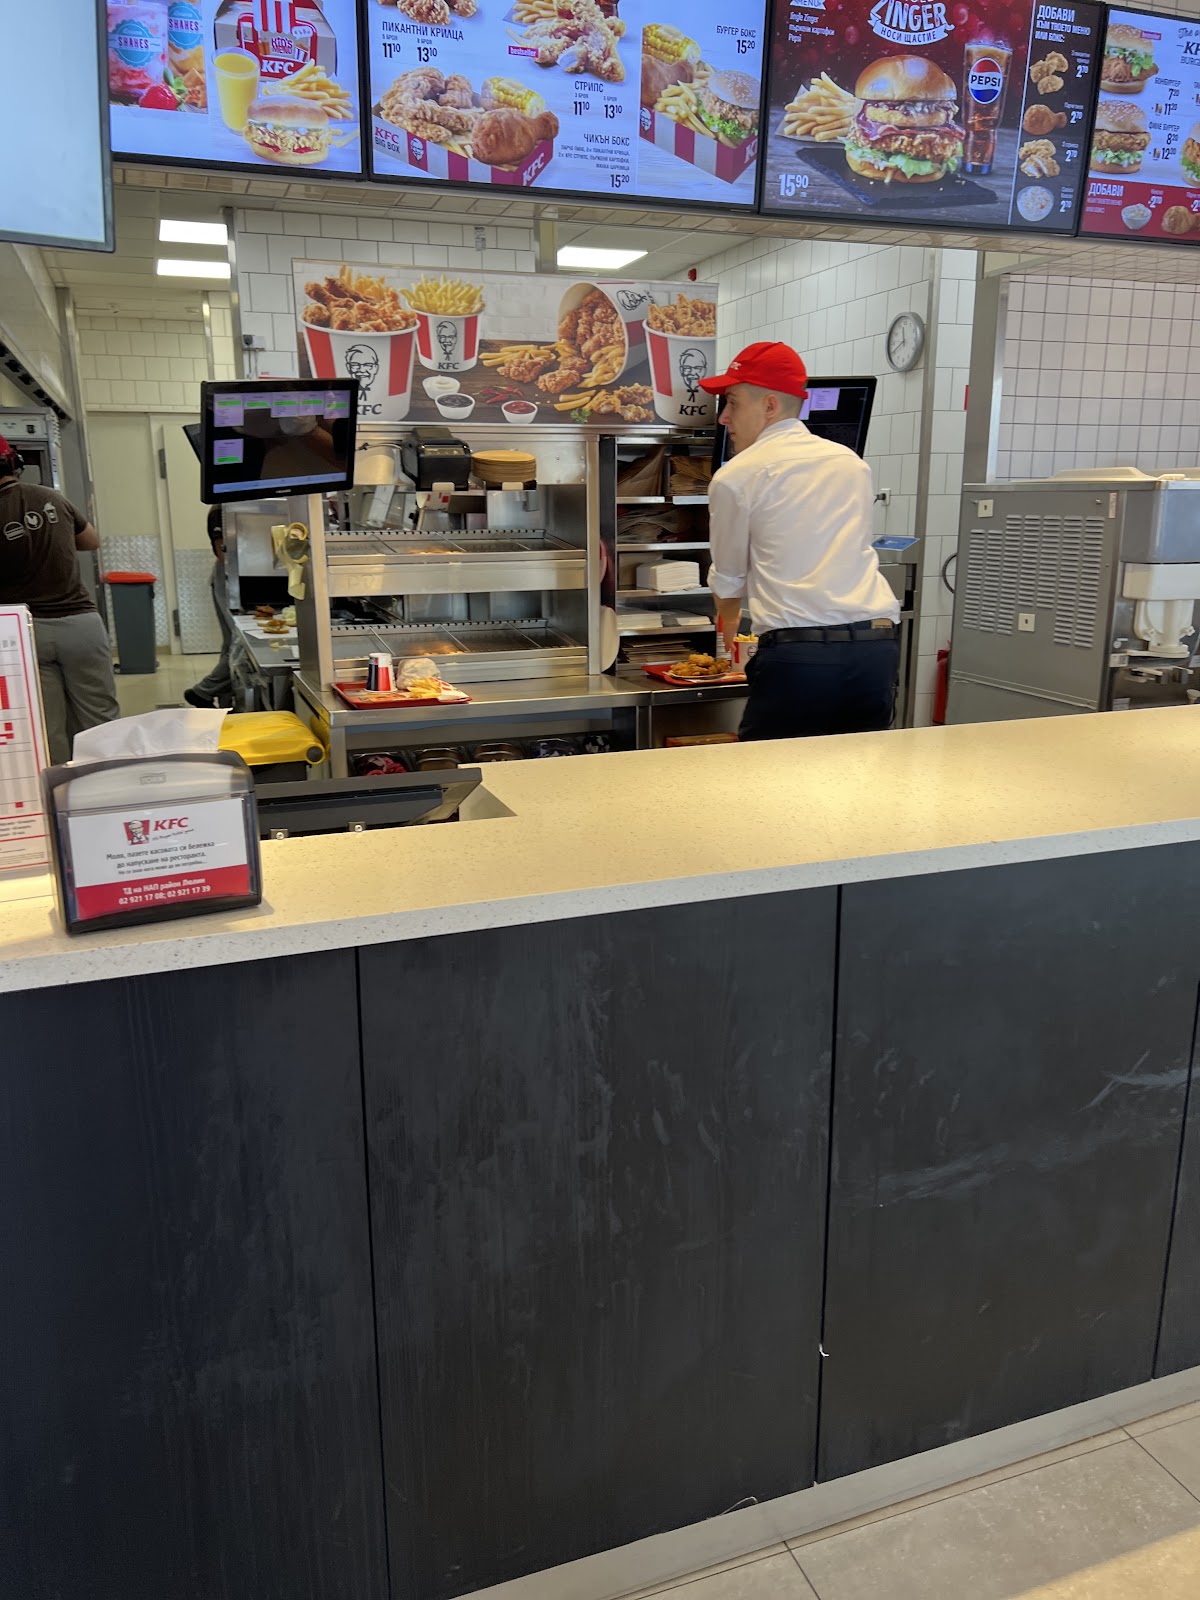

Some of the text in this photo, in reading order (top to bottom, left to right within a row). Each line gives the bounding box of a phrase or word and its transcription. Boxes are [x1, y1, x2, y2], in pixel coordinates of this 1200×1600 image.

[1037, 4, 1076, 22] ДОБАВИ
[168, 19, 199, 32] SHAKES
[382, 21, 464, 41] ПИКАНТНИ КРИЛЦА
[716, 25, 757, 38] БУРГЕР БОКС
[880, 27, 937, 44] НОСИ ЩАСТИЕ
[118, 36, 149, 49] SHAKES
[261, 60, 294, 74] KFC
[574, 81, 604, 92] СТРИПС
[970, 75, 1001, 88] PEPSI
[374, 126, 400, 144] KFC
[583, 133, 630, 146] ЧИКЪН БОКС
[387, 142, 400, 154] BOX
[522, 152, 545, 186] KFC
[1088, 182, 1124, 196] ДОБАВИ
[438, 362, 460, 370] KFC
[679, 404, 708, 416] KFC
[153, 817, 189, 832] KFC
[188, 842, 215, 850] бележка
[143, 883, 159, 892] НАП
[118, 897, 128, 905] 02
[129, 895, 142, 903] 921
[167, 890, 176, 898] 02
[177, 888, 190, 896] 921
[192, 886, 200, 894] 17
